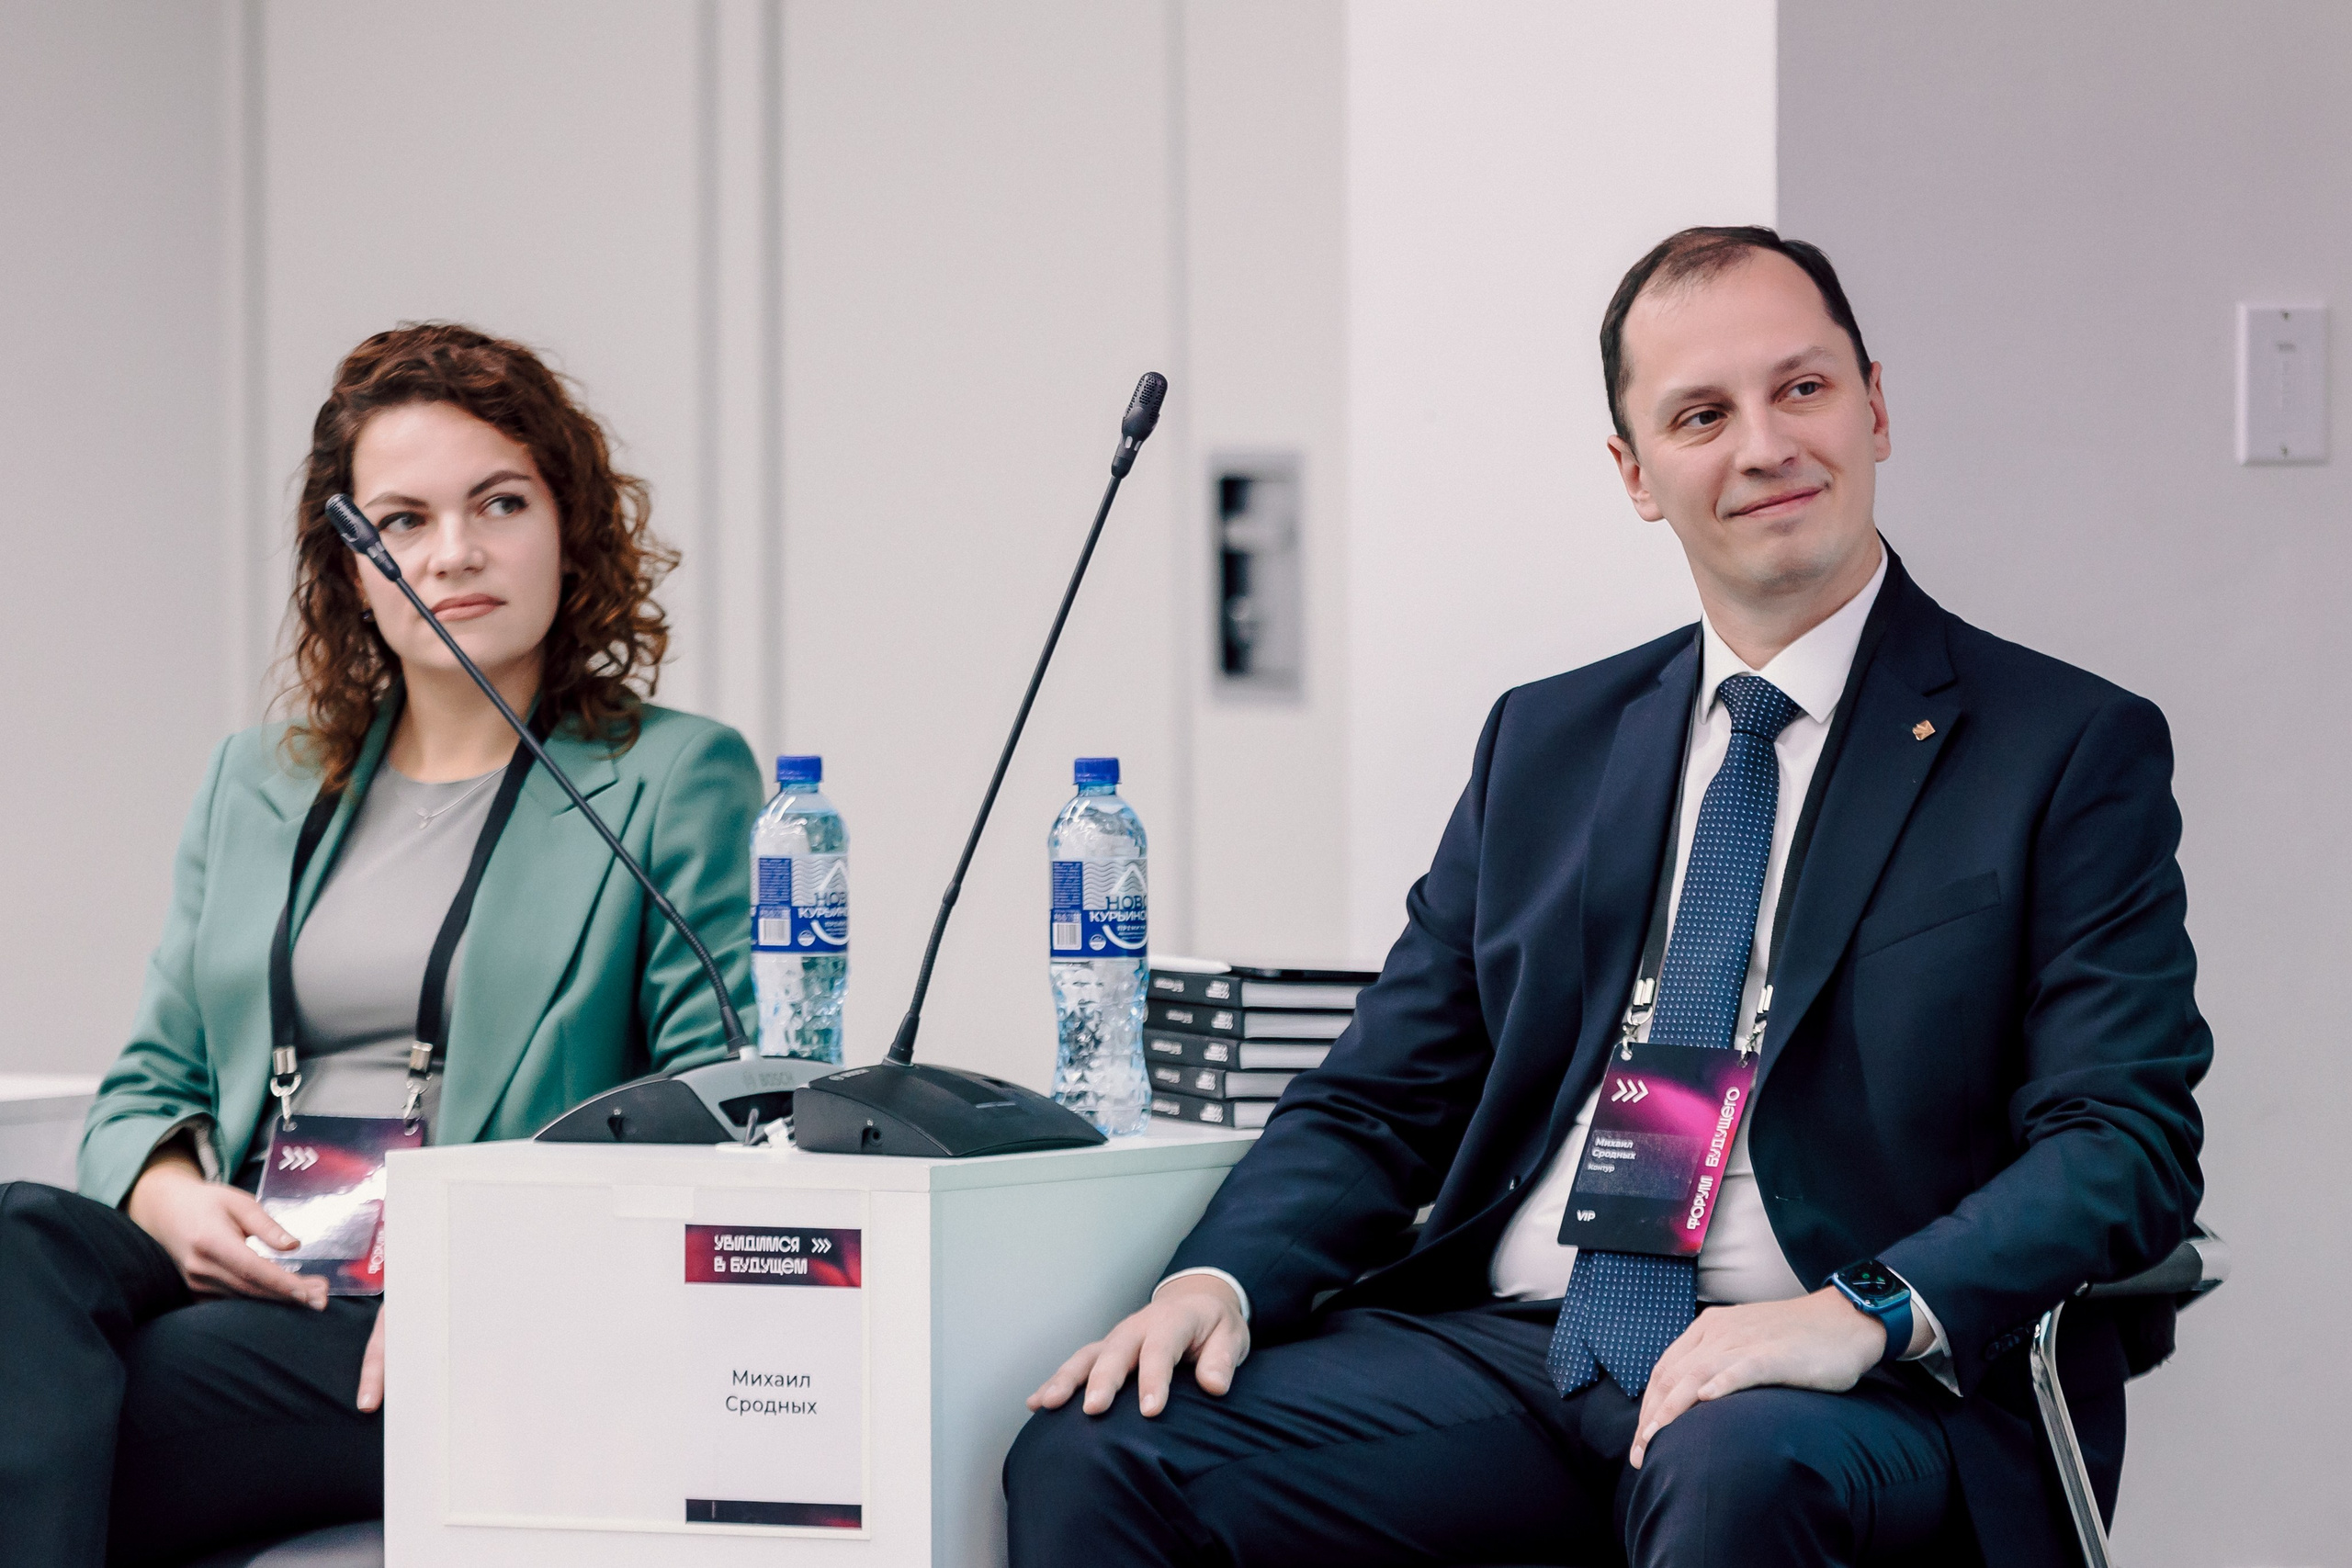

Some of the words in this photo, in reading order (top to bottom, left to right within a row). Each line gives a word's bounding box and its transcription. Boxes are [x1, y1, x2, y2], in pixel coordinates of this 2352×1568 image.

[1595, 1136, 1634, 1149] Михаил
[1591, 1147, 1636, 1160] Сродных
[1687, 1176, 1713, 1229] ФОРУМ
[1576, 1209, 1596, 1222] VIP
[714, 1235, 800, 1252] УВИДИМСЯ
[731, 1370, 811, 1388] Михаил
[725, 1395, 818, 1416] Сродных
